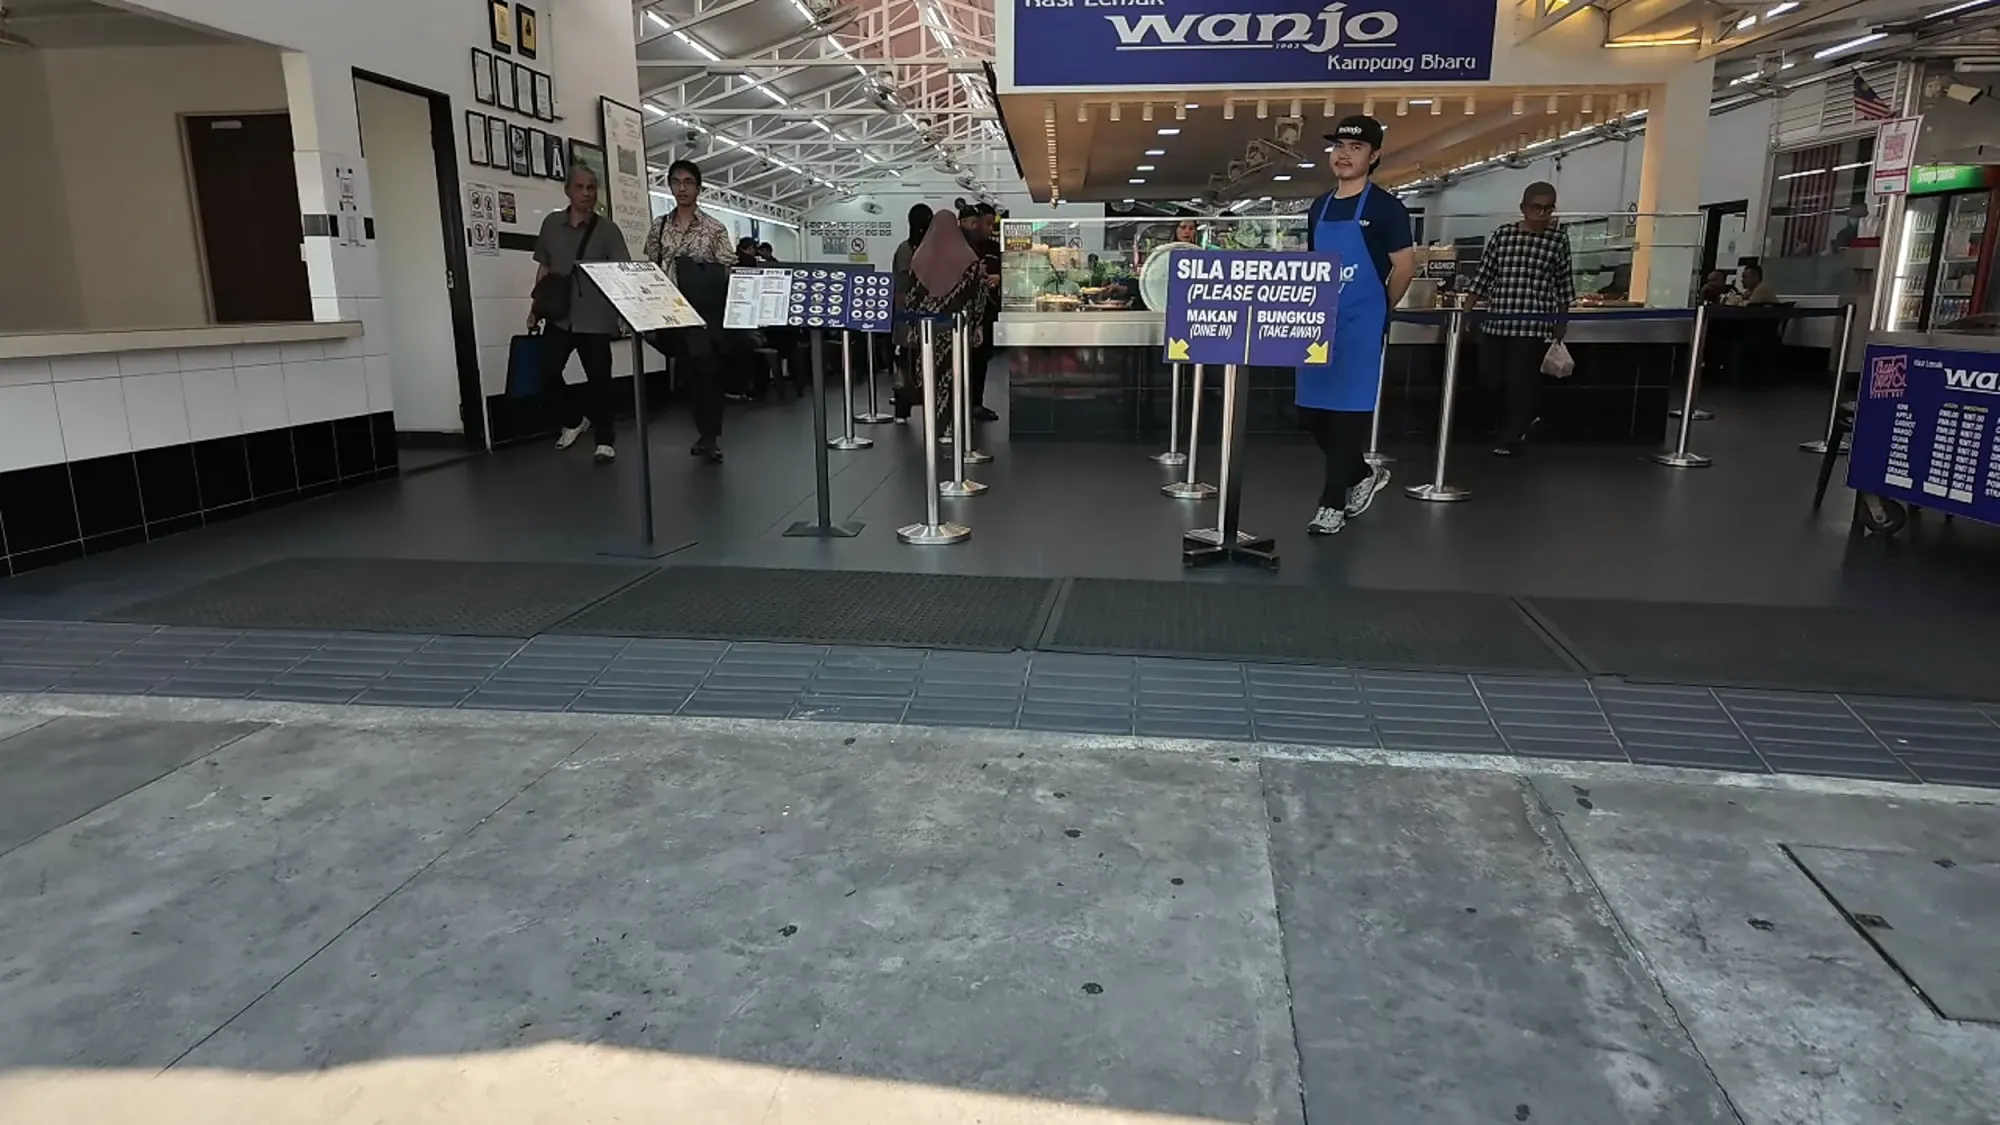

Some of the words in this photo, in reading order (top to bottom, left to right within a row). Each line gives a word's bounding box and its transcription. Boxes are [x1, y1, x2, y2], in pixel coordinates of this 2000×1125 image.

[1104, 2, 1399, 52] wanjo
[1327, 54, 1415, 73] Kampung
[1421, 54, 1477, 70] Bharu
[1178, 259, 1224, 280] SILA
[1231, 260, 1331, 282] BERATUR
[1188, 284, 1254, 303] (PLEASE
[1258, 286, 1317, 306] QUEUE)
[1187, 309, 1238, 323] MAKAN
[1257, 311, 1325, 324] BUNGKUS
[1190, 325, 1217, 339] (DINE
[1218, 326, 1233, 340] IN)
[1259, 325, 1289, 340] (TAKE
[1291, 327, 1321, 341] AWAY)
[1944, 368, 2000, 391] wa
